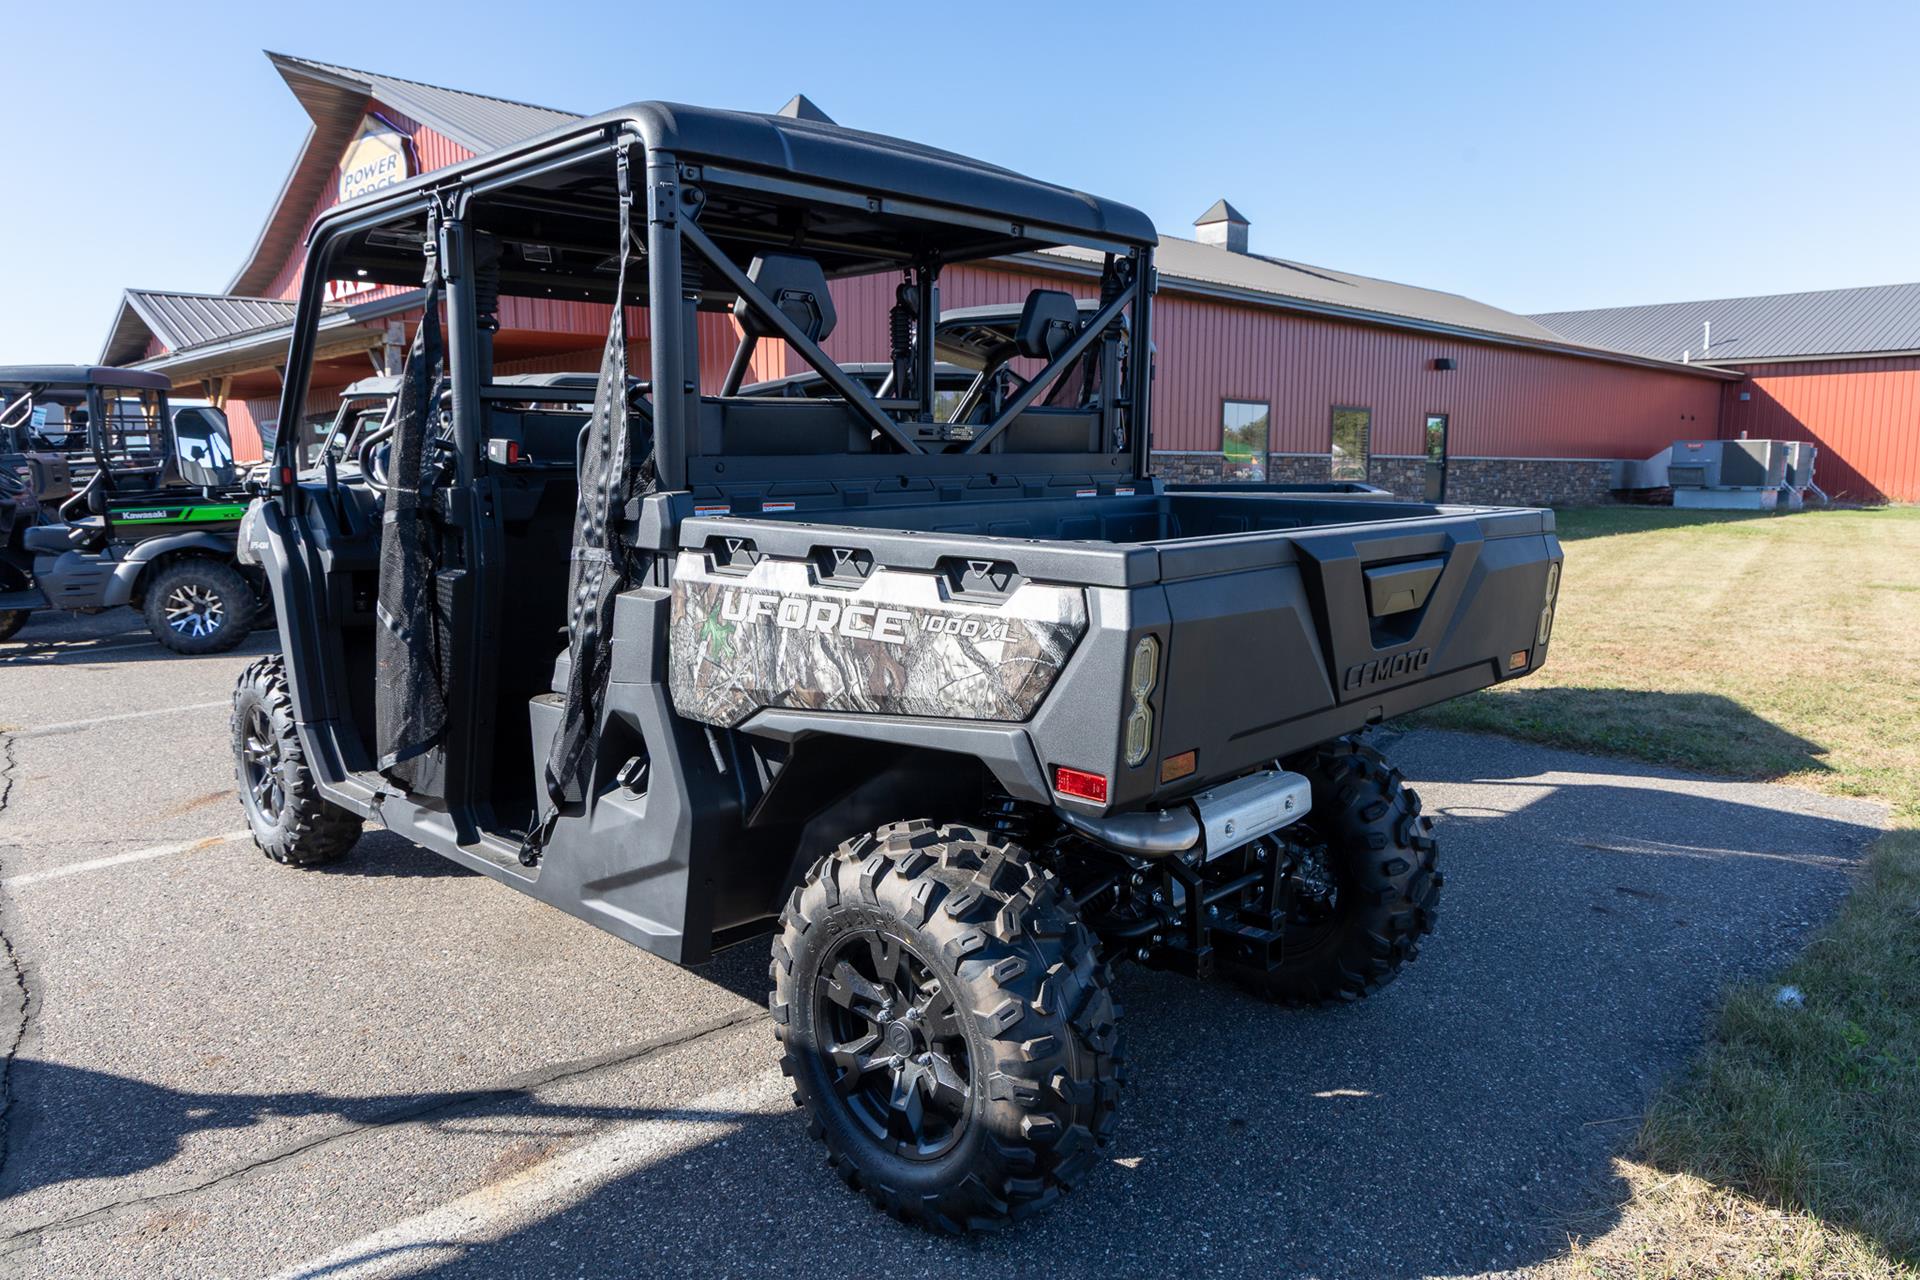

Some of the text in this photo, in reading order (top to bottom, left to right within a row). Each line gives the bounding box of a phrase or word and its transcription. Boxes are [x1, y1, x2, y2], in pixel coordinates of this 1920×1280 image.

[345, 154, 397, 192] POWER
[122, 510, 168, 520] Kawasaki
[721, 590, 1018, 645] UFORCE 1000 XL
[1344, 648, 1431, 691] CFMOTO
